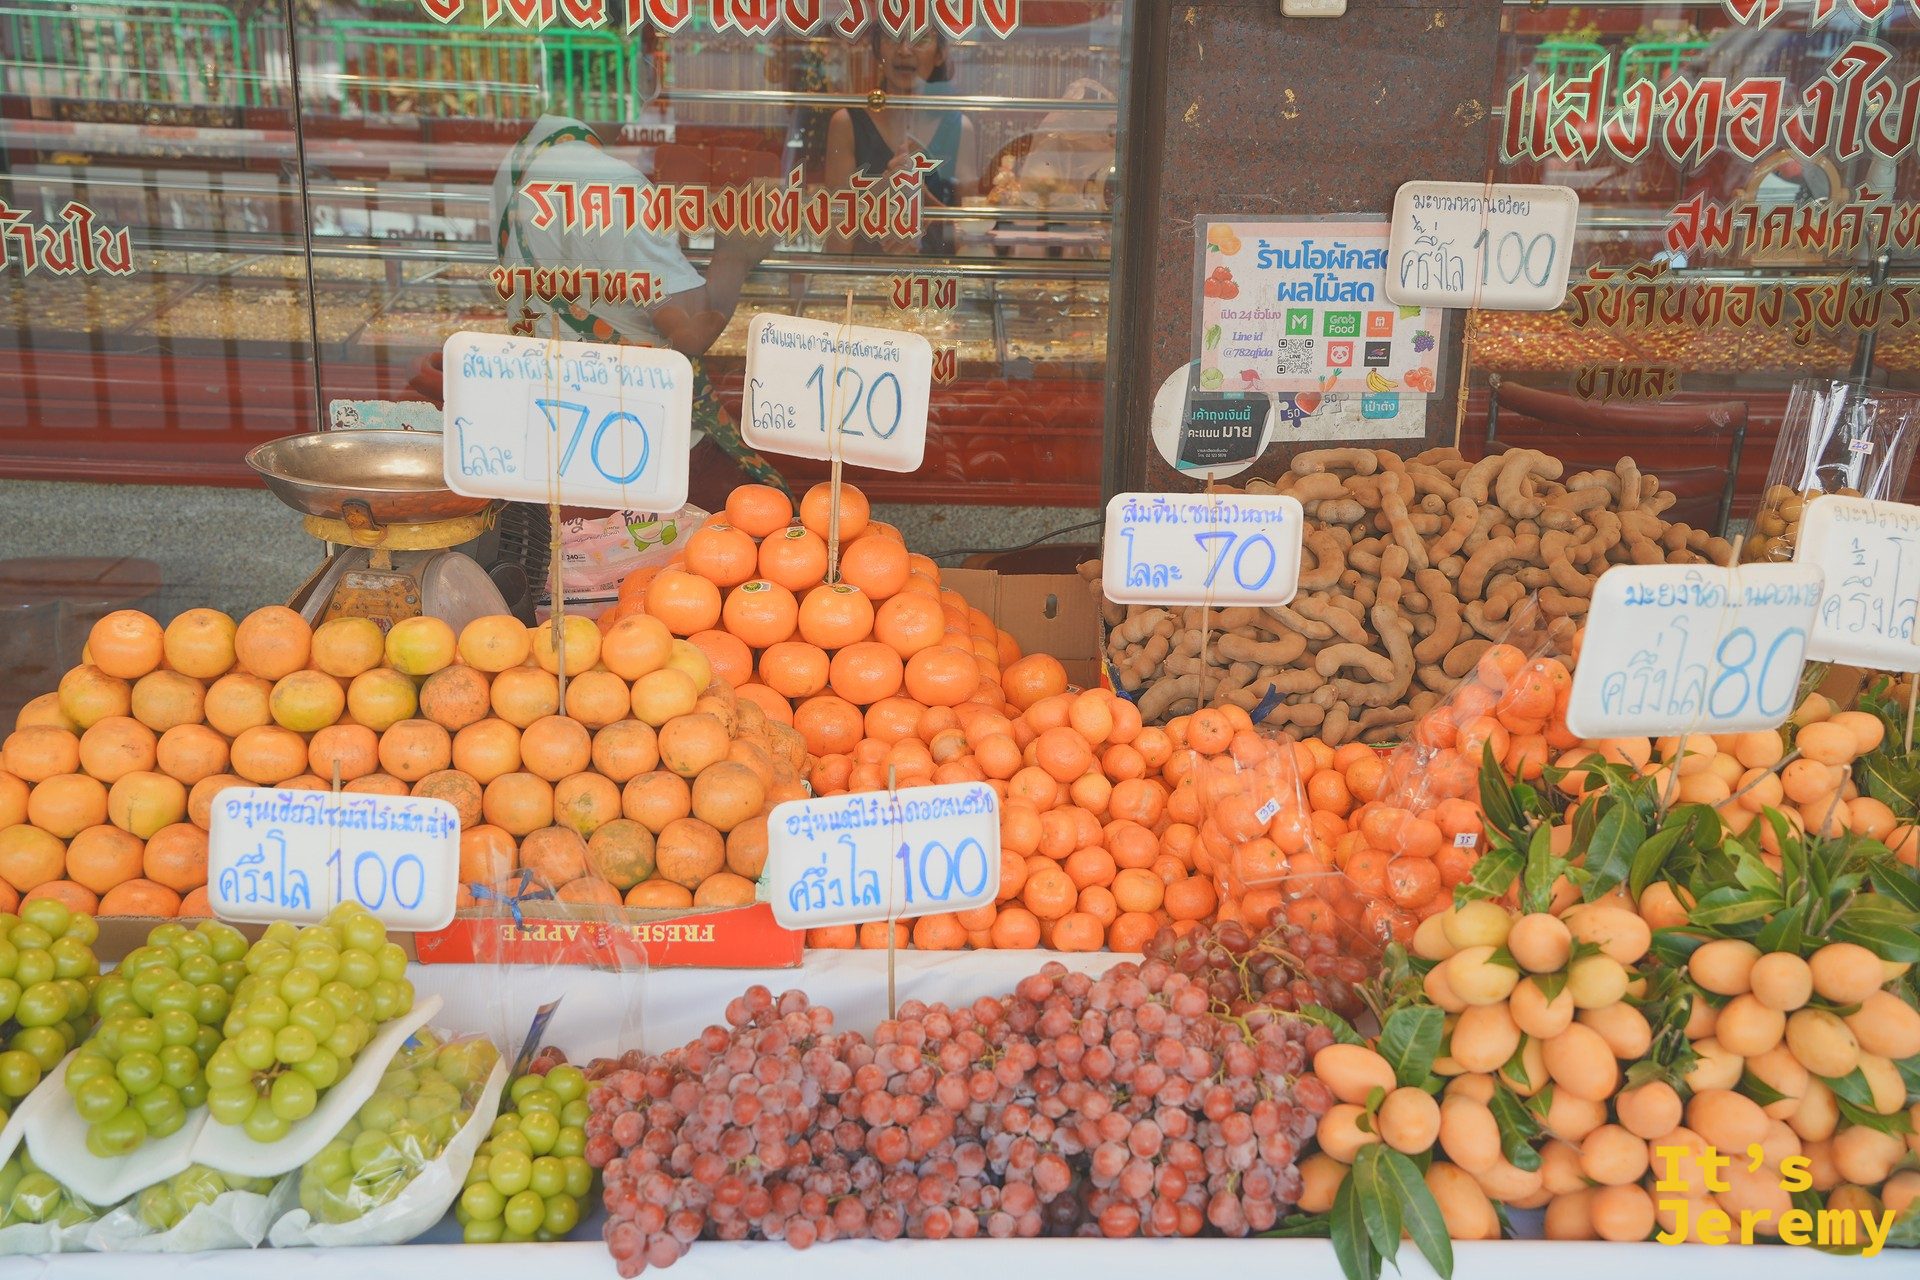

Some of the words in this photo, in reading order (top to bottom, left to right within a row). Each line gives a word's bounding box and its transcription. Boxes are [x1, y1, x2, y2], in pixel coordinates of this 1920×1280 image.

[1503, 40, 1920, 168] แสงทองใบ
[518, 152, 944, 242] ราคาทองแท่งวันนี้
[1412, 194, 1531, 216] มะขามหวานอร่อย
[1473, 228, 1557, 288] 100
[490, 263, 667, 309] ขายบาทละ
[889, 273, 961, 314] บาท
[1277, 273, 1375, 302] ผลไม้สด
[1568, 259, 1920, 347] รับคืนทองรูปพร
[1220, 309, 1236, 320] เปิด
[1238, 311, 1252, 321] 24
[1253, 307, 1282, 320] ชั่วโมง
[1328, 324, 1355, 334] Food
[1329, 315, 1356, 324] Grab
[1232, 331, 1252, 341] Line
[1253, 331, 1263, 341] id
[750, 378, 797, 430] โลละ
[805, 363, 902, 440] 120
[1324, 394, 1338, 404] 50
[1574, 364, 1680, 405] บาทละ
[1188, 428, 1220, 438] คะแนน
[1222, 425, 1252, 438] มาย
[1287, 408, 1300, 418] 50
[455, 416, 517, 476] โลละ
[535, 398, 650, 485] 70
[1120, 527, 1183, 589] โลละ
[1194, 531, 1276, 591] 70
[1602, 616, 1708, 717] ครึ่งโล
[1708, 626, 1807, 719] 80
[219, 829, 312, 911] ครึ่งโล
[326, 848, 426, 911] 100
[788, 834, 882, 912] ครึ่งโล
[895, 836, 989, 904] 100
[502, 924, 581, 942] APPLE
[632, 924, 716, 943] FRESH
